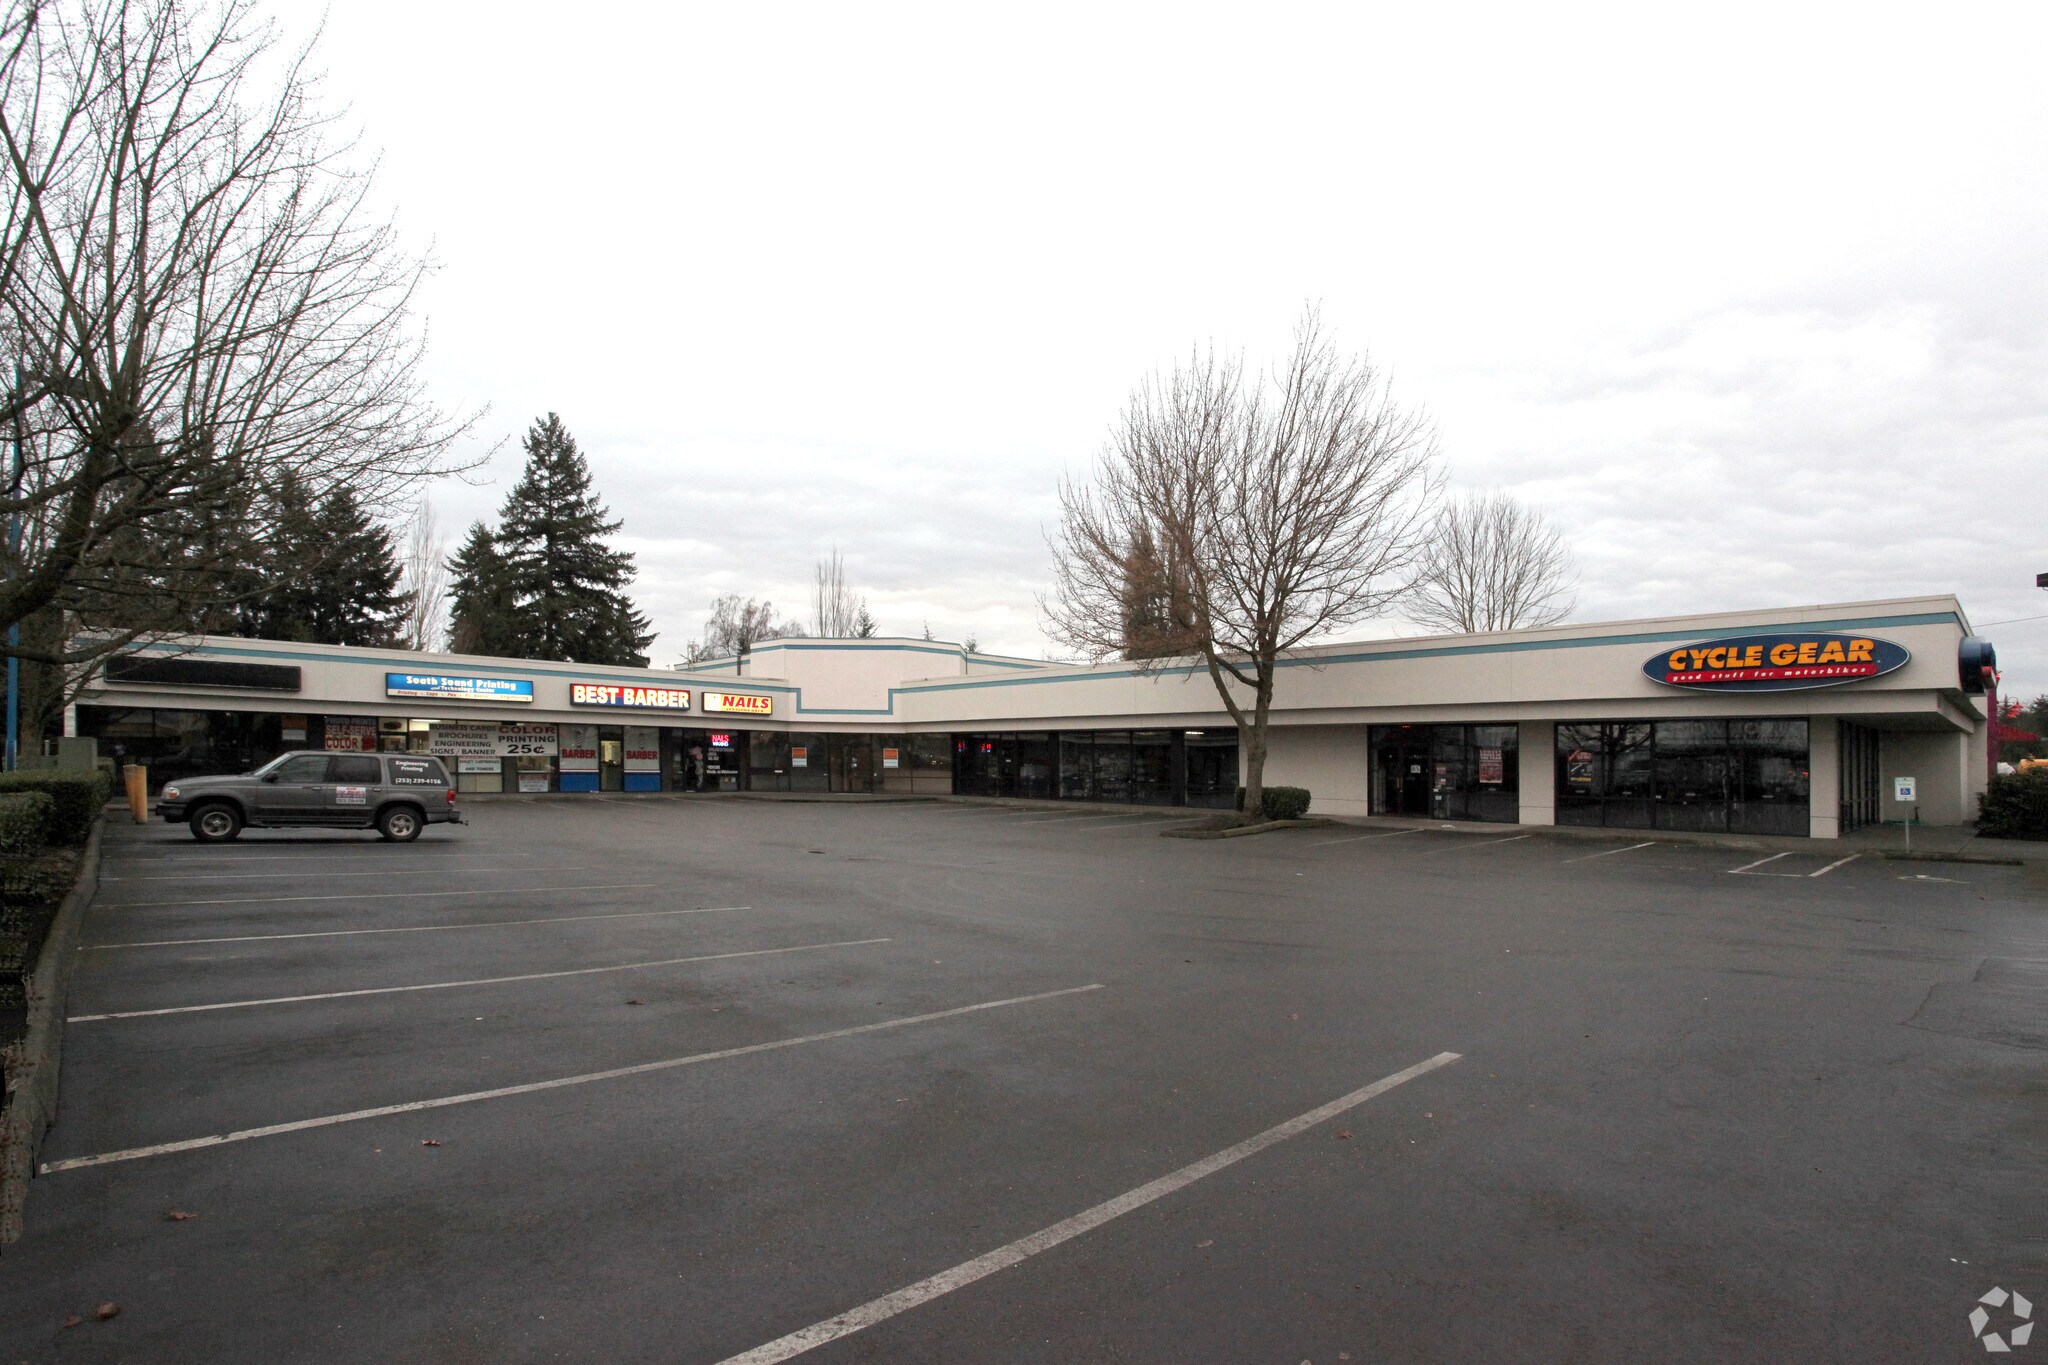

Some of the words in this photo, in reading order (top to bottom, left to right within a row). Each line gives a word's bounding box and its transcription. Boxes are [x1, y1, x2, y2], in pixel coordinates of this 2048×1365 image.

[1668, 645, 1763, 671] CYCLE
[1769, 639, 1875, 666] GEAR
[1672, 674, 1702, 682] good
[1711, 671, 1744, 679] stuff
[1784, 667, 1866, 676] motorbikes
[476, 679, 517, 692] Printing
[573, 685, 619, 704] BEST
[623, 688, 690, 708] BARBER
[723, 696, 769, 709] NAILS
[326, 725, 377, 736] SELF-SERVE
[498, 726, 556, 734] COLOR
[326, 737, 358, 749] COLOR
[498, 735, 556, 743] PRINTING
[711, 734, 730, 742] NAILS
[507, 744, 545, 754] 25¢
[561, 749, 597, 759] BARBER
[626, 750, 658, 760] BARBER
